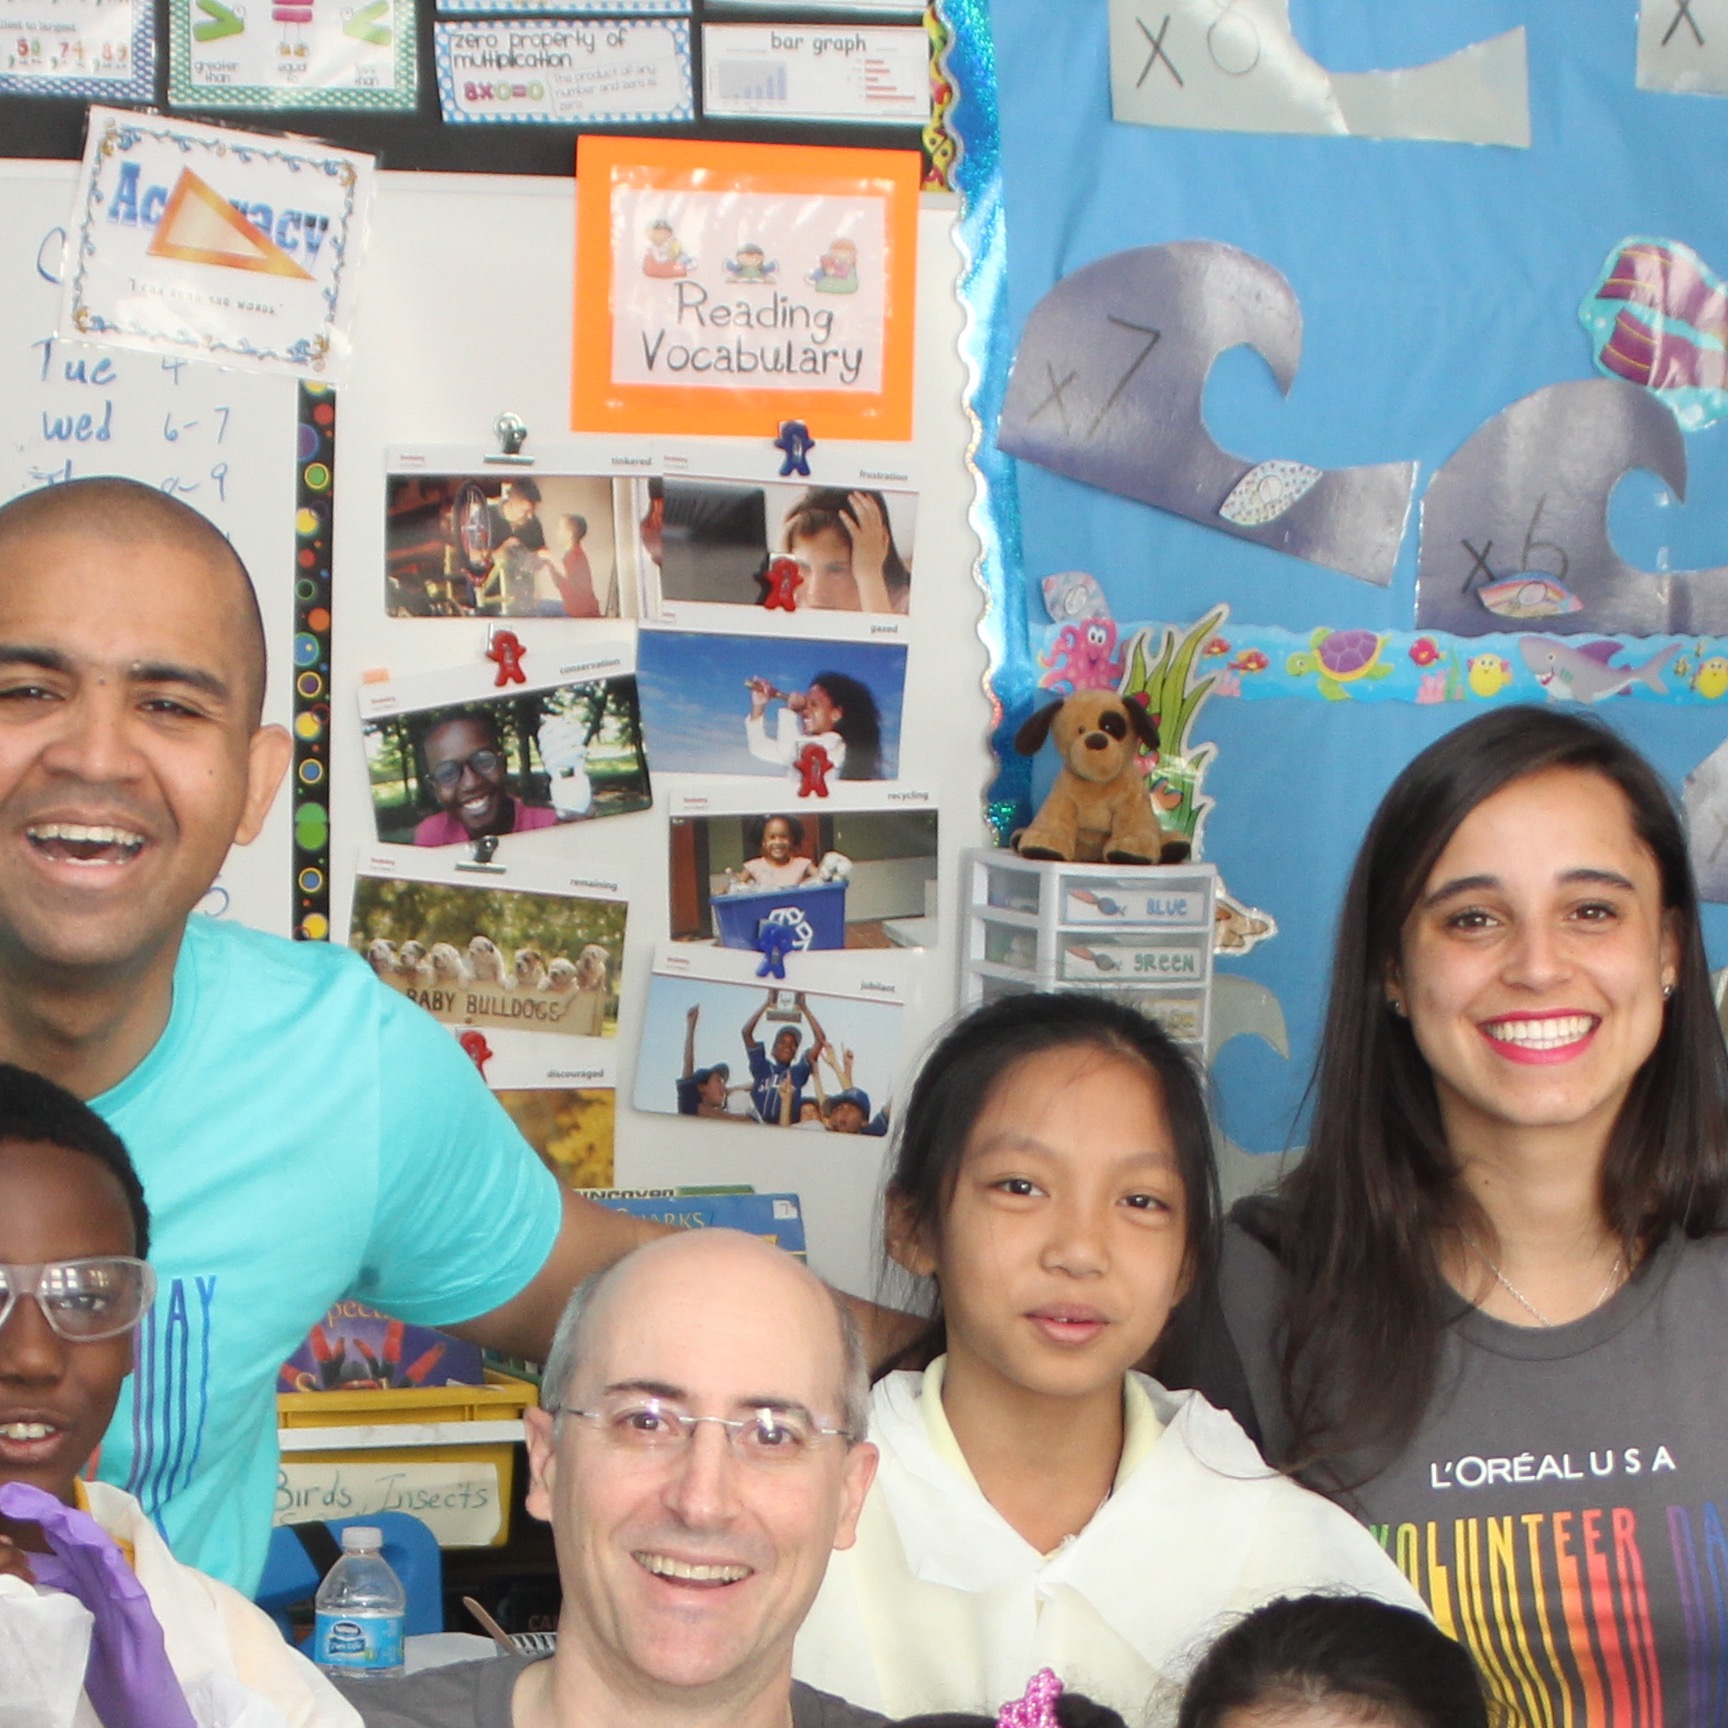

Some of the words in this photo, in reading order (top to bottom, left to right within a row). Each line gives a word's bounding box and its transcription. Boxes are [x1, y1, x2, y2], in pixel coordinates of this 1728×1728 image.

[454, 33, 498, 49] zero
[509, 29, 595, 53] property
[606, 28, 628, 47] of
[771, 32, 804, 50] bar
[813, 33, 867, 57] graph
[194, 59, 239, 75] greater
[454, 51, 572, 70] multiplication
[205, 70, 230, 83] than
[674, 278, 835, 345] Reading
[31, 337, 116, 385] Tue
[640, 327, 863, 386] Vocabulary
[611, 455, 652, 467] tinkered
[858, 468, 909, 482] frustration
[870, 624, 899, 636] gazed
[559, 656, 621, 676] conservation
[887, 790, 930, 803] recycling
[570, 877, 619, 893] remaining
[860, 979, 896, 994] jubilant
[466, 993, 563, 1022] BULLDOGS
[547, 1067, 604, 1080] discouraged
[1430, 1453, 1584, 1489] L'ORÉAL
[374, 1472, 489, 1511] Insects
